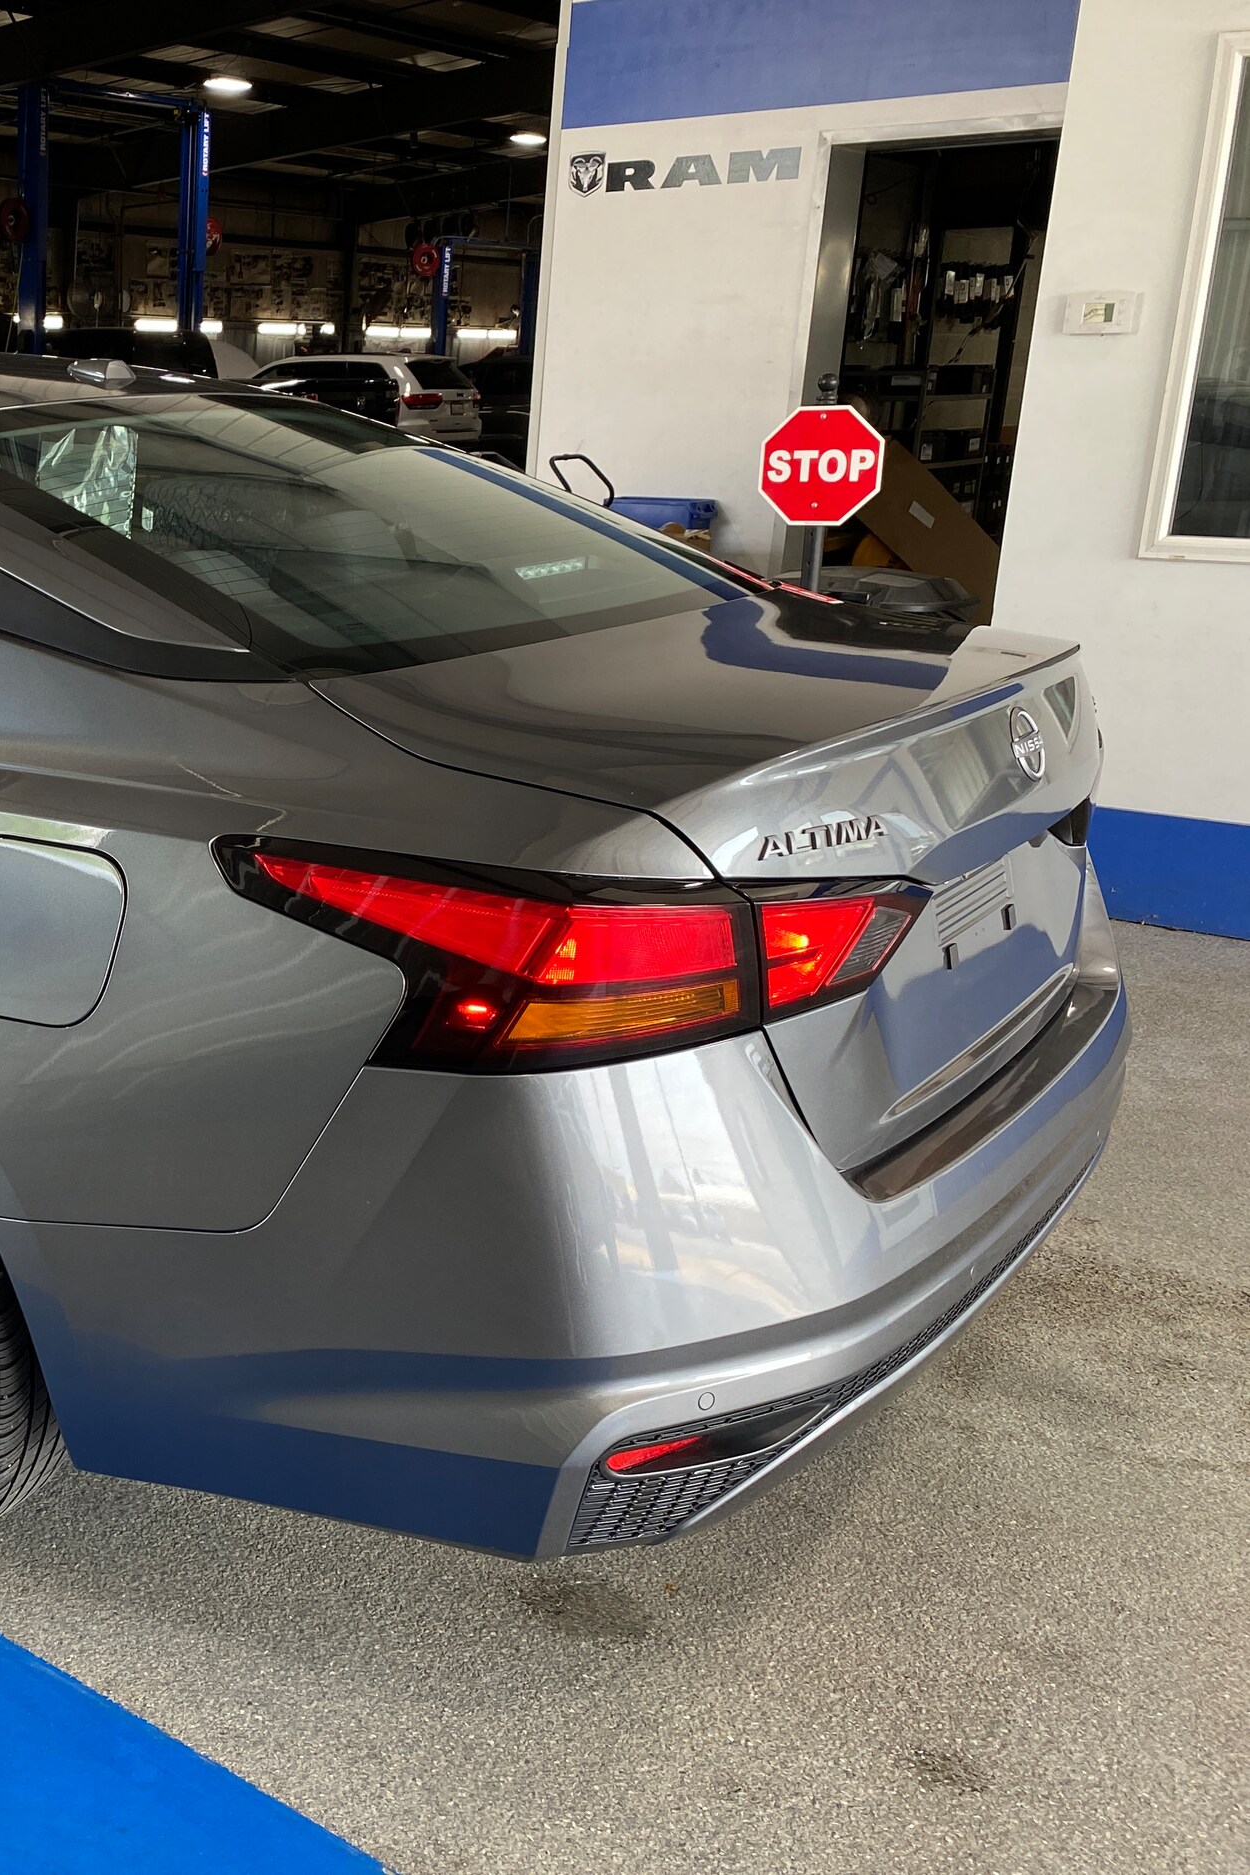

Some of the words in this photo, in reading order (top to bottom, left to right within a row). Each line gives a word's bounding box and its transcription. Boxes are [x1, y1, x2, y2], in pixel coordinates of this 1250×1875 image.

[202, 133, 210, 171] ROTARY
[605, 146, 802, 193] RAM
[444, 246, 452, 263] LIFT
[442, 264, 451, 293] ROTARY
[767, 448, 876, 483] STOP
[1013, 736, 1044, 756] NISS
[757, 814, 889, 861] ALTIMA
